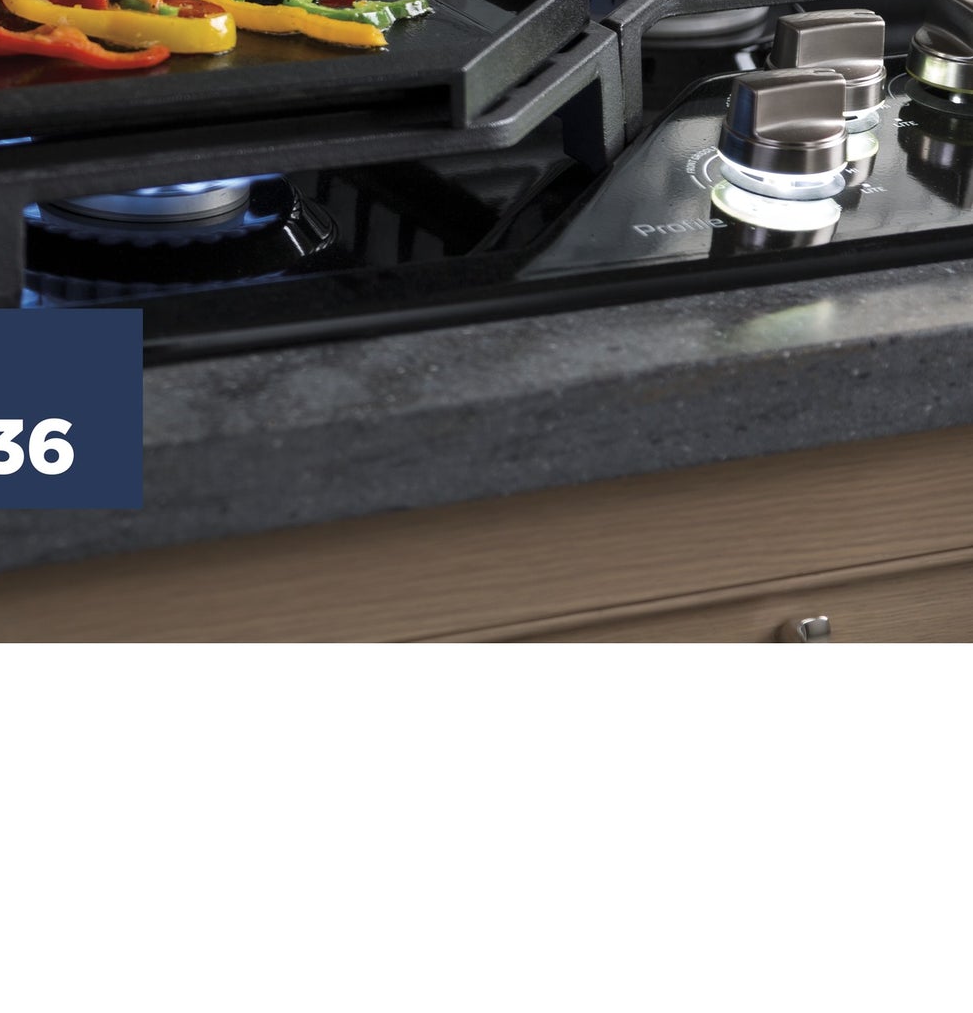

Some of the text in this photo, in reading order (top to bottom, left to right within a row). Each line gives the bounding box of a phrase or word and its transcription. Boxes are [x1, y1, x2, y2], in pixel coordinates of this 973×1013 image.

[893, 120, 919, 128] LITE
[860, 186, 888, 194] LITE
[633, 216, 728, 237] Profile
